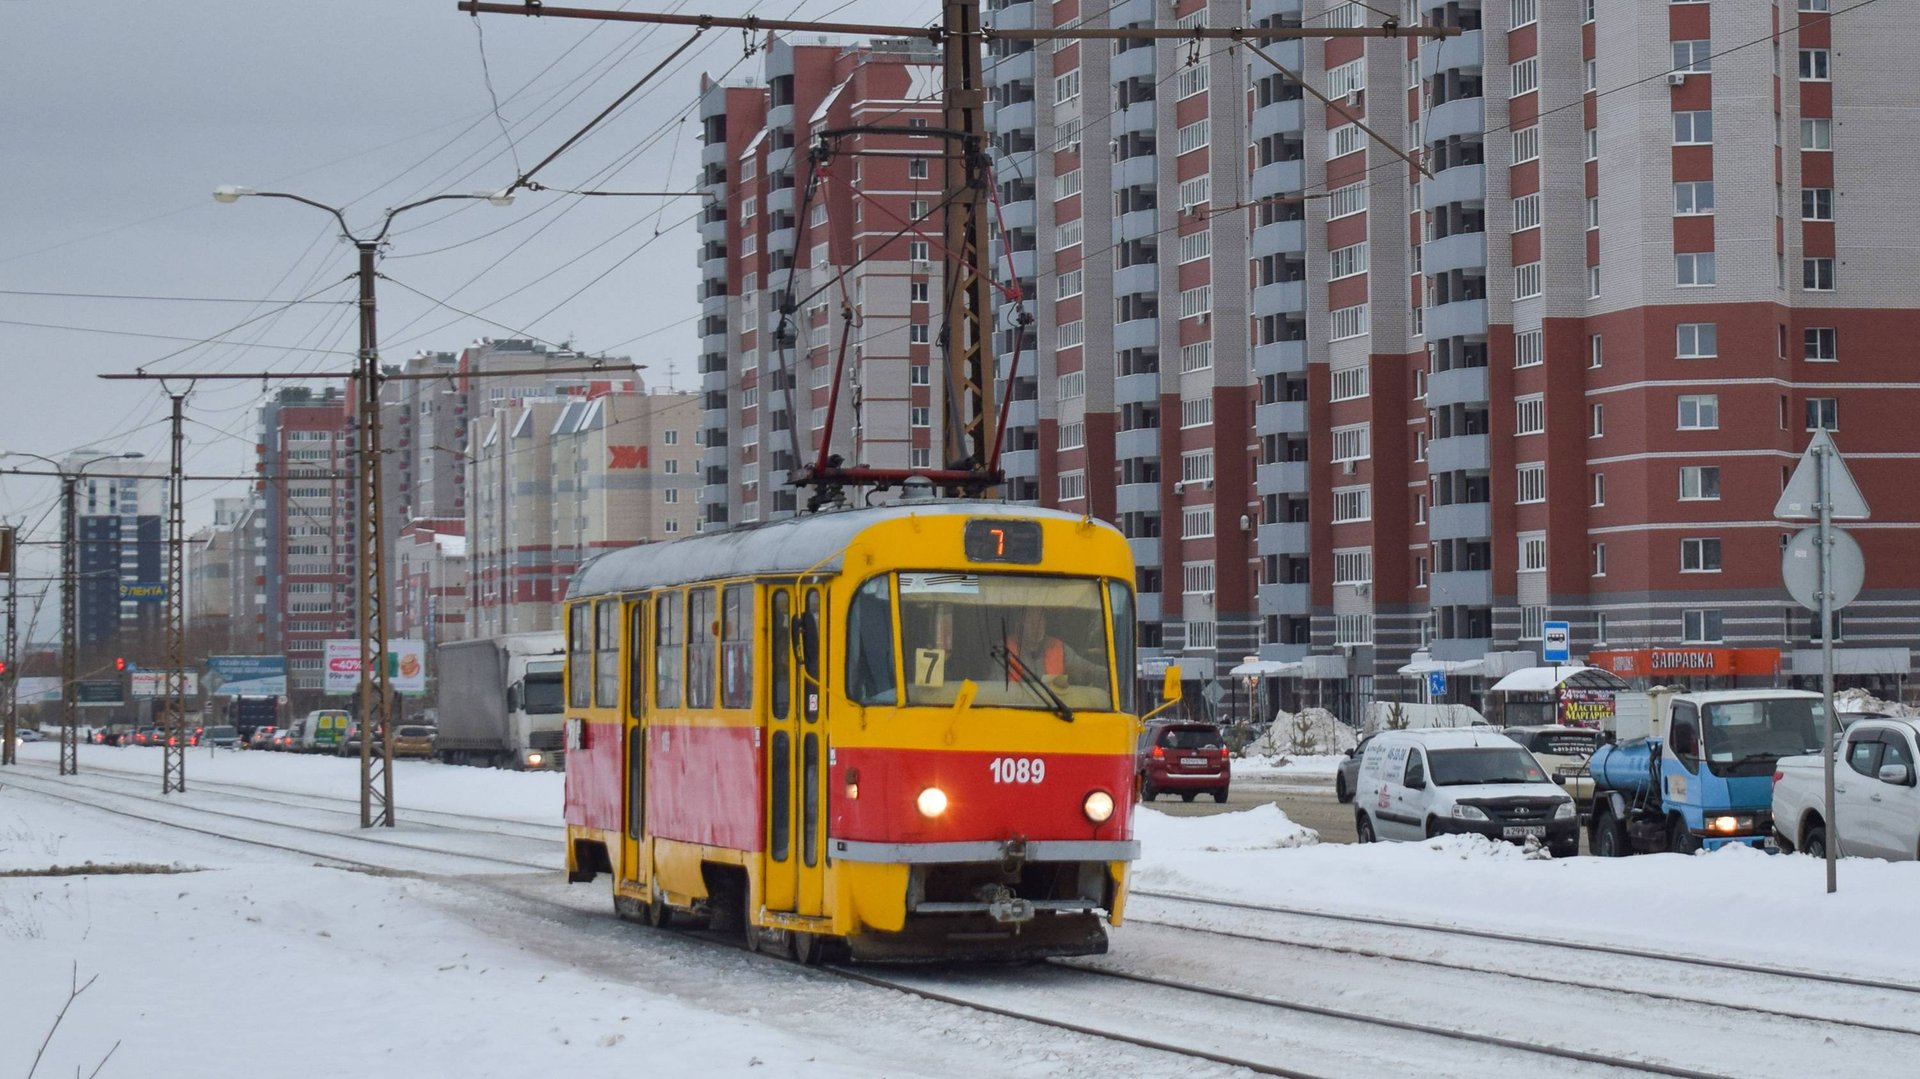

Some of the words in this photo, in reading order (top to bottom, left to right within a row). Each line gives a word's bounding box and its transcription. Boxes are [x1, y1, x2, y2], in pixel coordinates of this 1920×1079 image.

[990, 529, 1004, 556] 7
[923, 652, 940, 684] 7
[1651, 652, 1714, 669] ЗАПРАВКА
[1560, 689, 1573, 700] 24
[1567, 702, 1604, 712] МАСТЕР
[989, 757, 1046, 784] 1089
